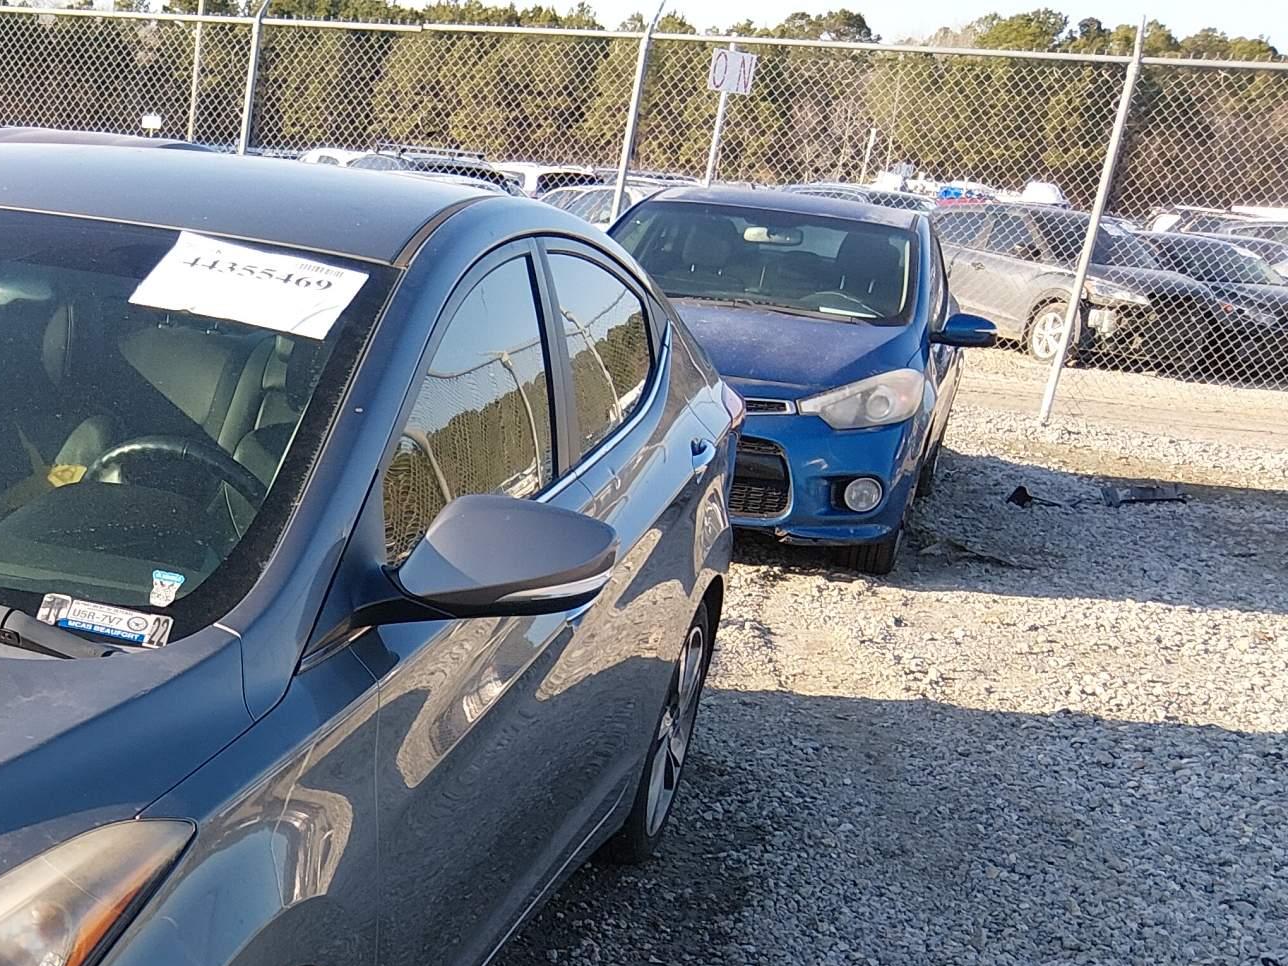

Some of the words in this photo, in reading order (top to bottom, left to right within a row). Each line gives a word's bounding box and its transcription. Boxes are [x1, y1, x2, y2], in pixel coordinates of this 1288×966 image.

[184, 256, 333, 290] 44355469
[68, 620, 92, 631] MCAS
[93, 624, 140, 641] BEAUFORT
[147, 616, 170, 647] 22
